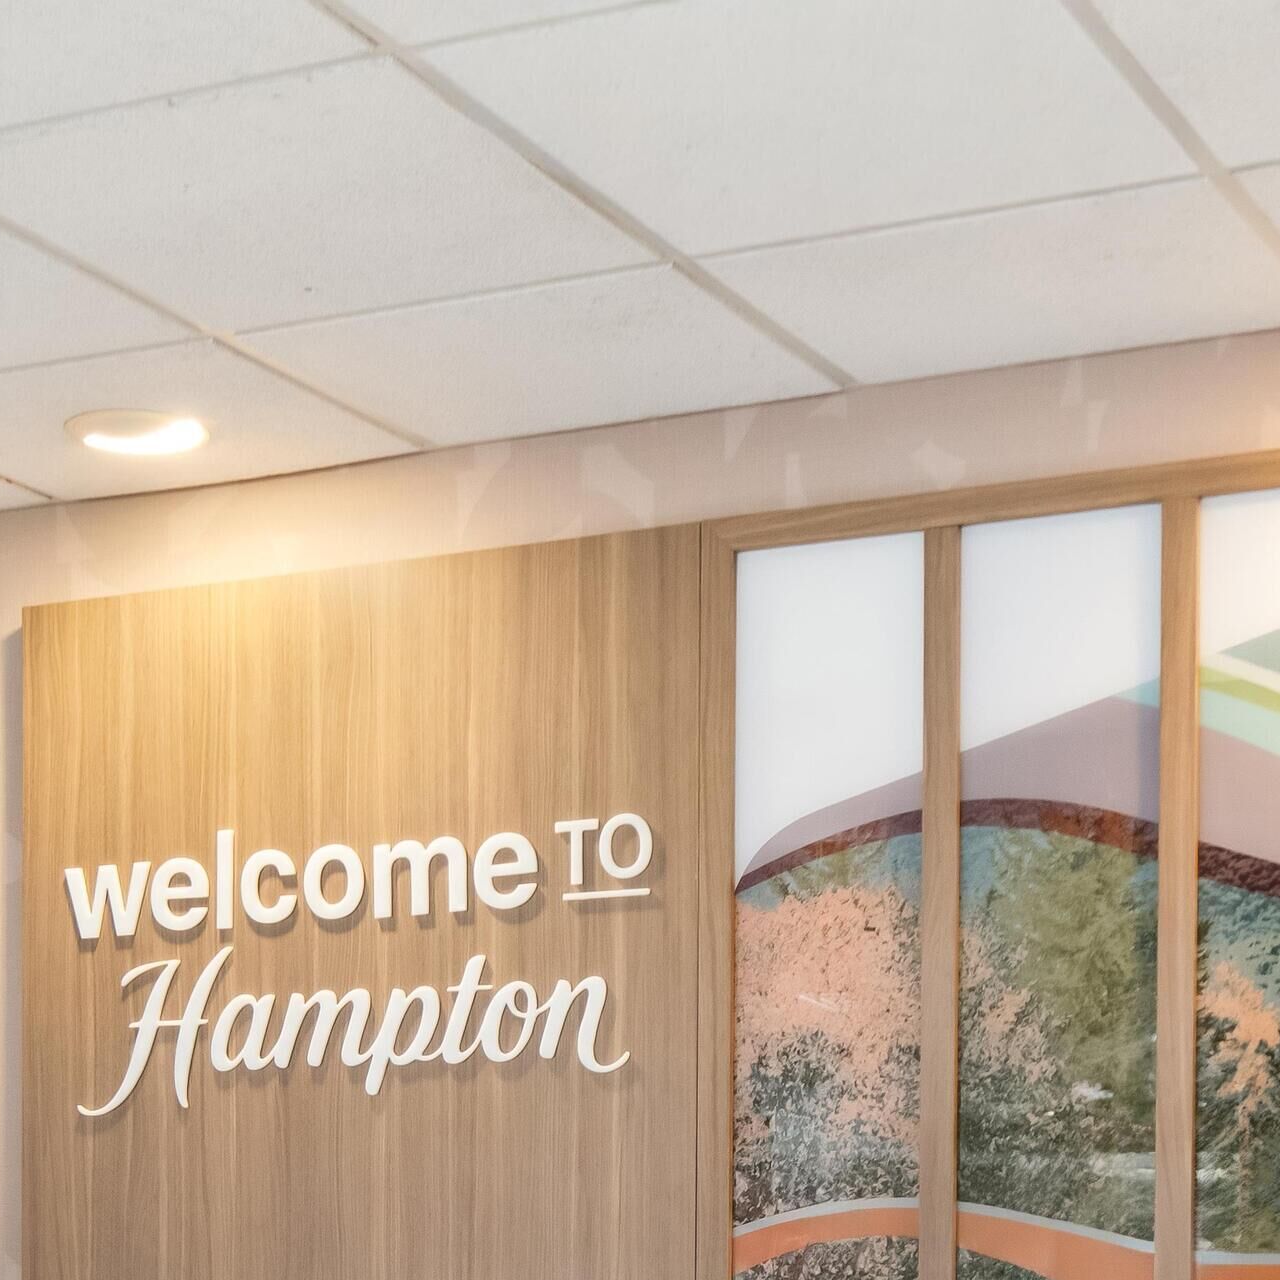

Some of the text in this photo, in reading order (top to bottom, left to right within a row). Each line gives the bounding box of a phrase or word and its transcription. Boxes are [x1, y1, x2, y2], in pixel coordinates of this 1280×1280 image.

[63, 812, 654, 940] welcome TO
[76, 945, 631, 1117] Hampton
